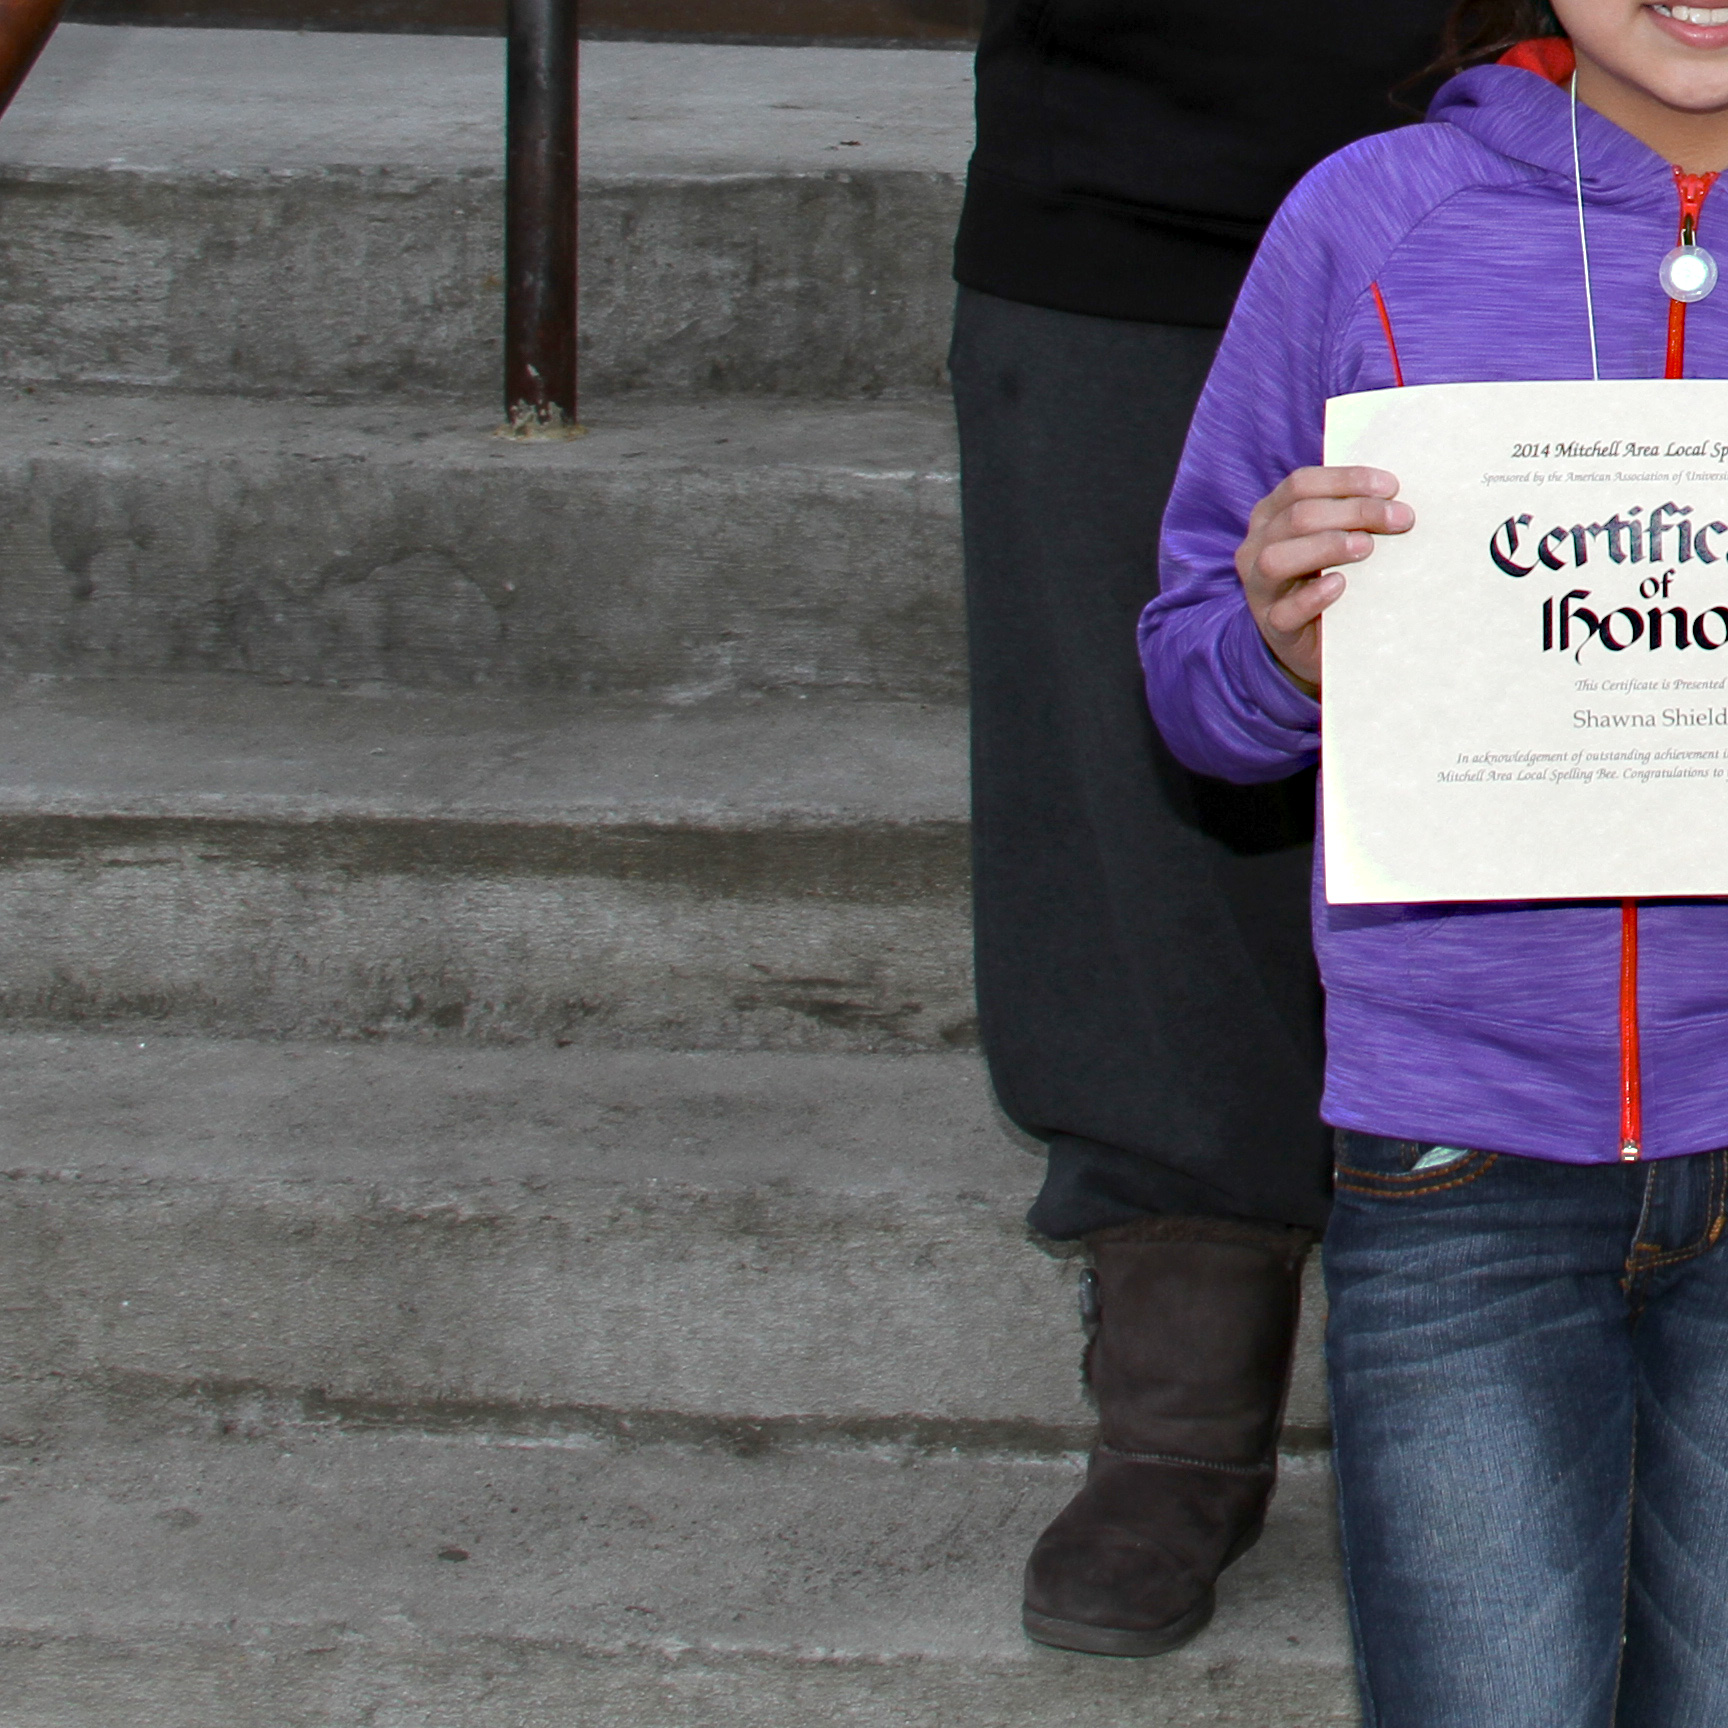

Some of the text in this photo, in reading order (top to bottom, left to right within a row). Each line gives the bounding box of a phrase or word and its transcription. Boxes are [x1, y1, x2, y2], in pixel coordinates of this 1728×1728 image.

[1511, 443, 1550, 458] 2014
[1554, 440, 1623, 458] Mitchell
[1622, 442, 1660, 457] Area
[1663, 440, 1710, 457] Local
[1481, 472, 1531, 486] Sponsored
[1533, 471, 1545, 486] by
[1548, 471, 1563, 482] the
[1565, 472, 1611, 482] American
[1613, 471, 1669, 482] Association
[1672, 470, 1684, 485] of
[1639, 569, 1676, 600] of
[1575, 679, 1598, 691] This
[1601, 678, 1658, 695] Certificate
[1662, 679, 1670, 690] is
[1673, 677, 1727, 690] Presented
[1573, 710, 1656, 728] Shawna
[1457, 753, 1469, 764] In
[1472, 750, 1568, 767] acknowledgement
[1571, 749, 1584, 766] of
[1586, 748, 1651, 765] outstanding
[1654, 747, 1719, 760] achievement
[1437, 769, 1486, 783] Mitchell
[1486, 770, 1512, 781] Area
[1516, 768, 1549, 781] Local
[1549, 767, 1593, 785] Spelling
[1596, 768, 1619, 779] Bee.
[1623, 766, 1709, 783] Congratulations
[1713, 768, 1724, 778] to
